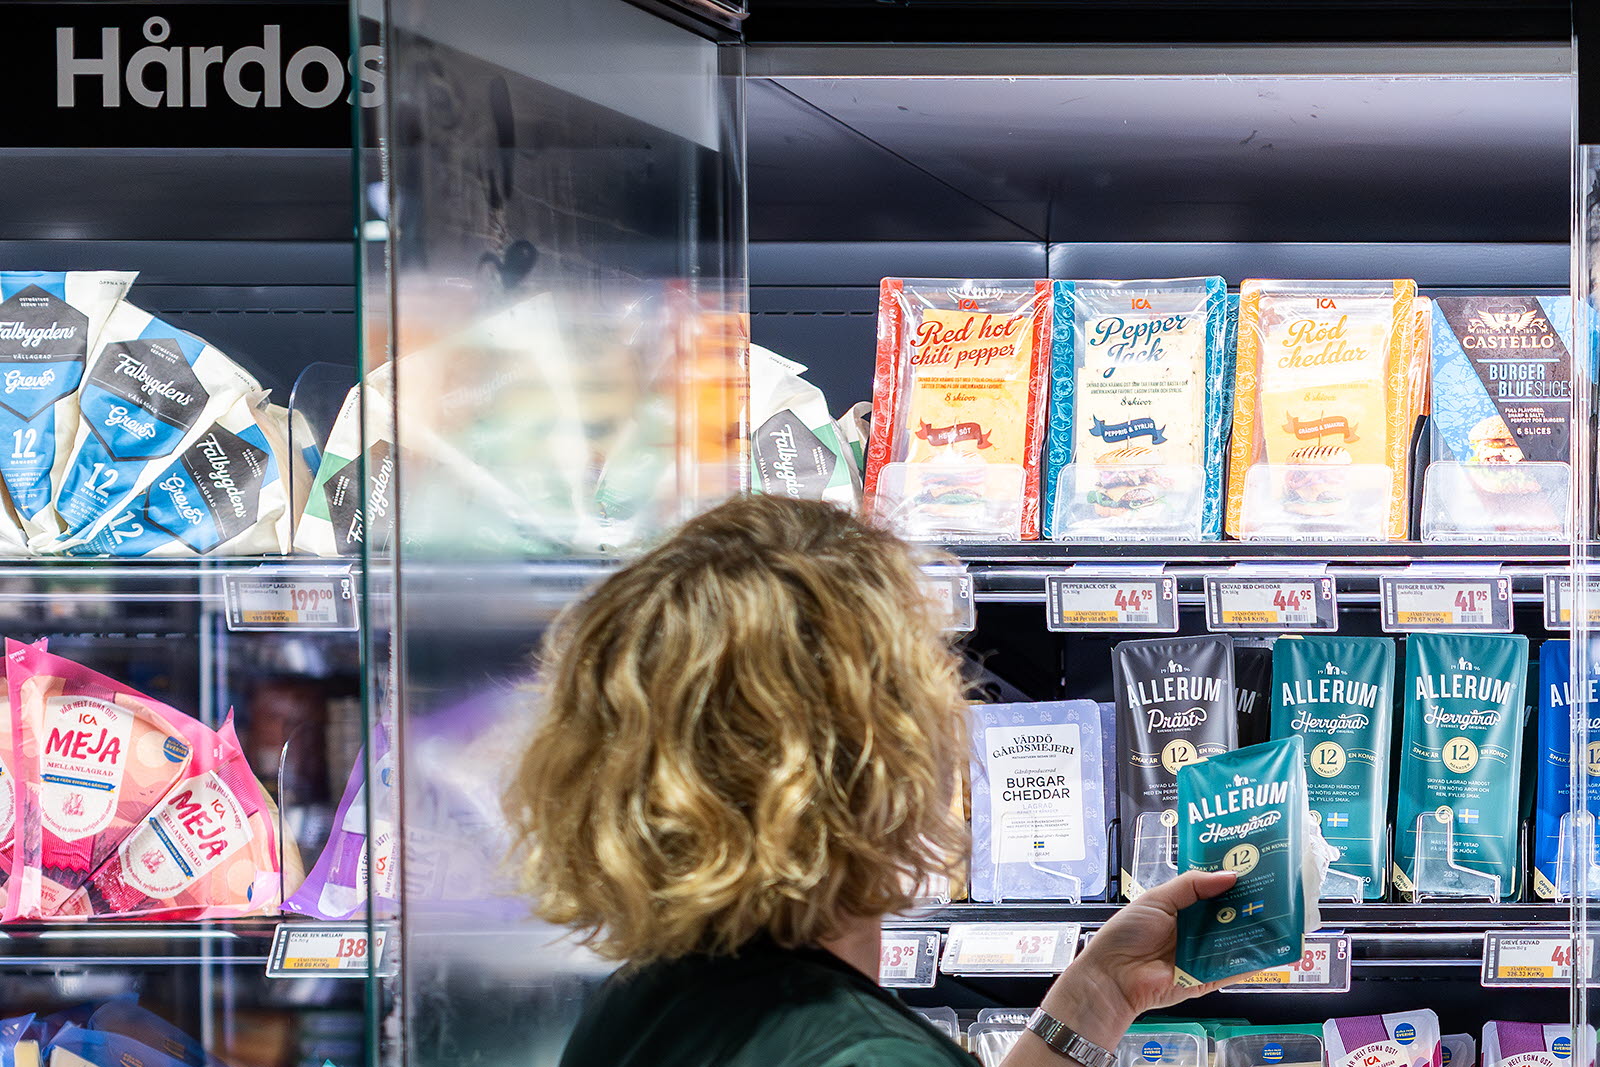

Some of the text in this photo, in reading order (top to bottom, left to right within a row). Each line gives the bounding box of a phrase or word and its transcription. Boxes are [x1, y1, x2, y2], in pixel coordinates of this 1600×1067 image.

[958, 298, 979, 310] ICA
[1131, 298, 1152, 310] ICA
[1316, 298, 1337, 310] ICA
[909, 313, 1022, 349] Red hot
[1090, 313, 1190, 347] Pepper
[1283, 314, 1348, 349] Röd
[1462, 334, 1554, 350] CASTELLO
[909, 343, 1016, 369] chili pepper
[1278, 339, 1371, 369] cheddar
[113, 352, 195, 406] Falbygdens
[1489, 364, 1546, 380] BURGER
[11, 428, 37, 458] 12
[84, 462, 119, 499] 12
[195, 432, 247, 519] Falbygdens
[111, 510, 145, 545] 12
[1126, 676, 1222, 709] ALLERUM
[1282, 678, 1378, 709] ALLERUM
[1416, 674, 1511, 705] ALLERUM
[78, 713, 98, 726] ICA
[1147, 706, 1207, 733] Präst
[1291, 710, 1370, 735] Herrgård
[1424, 705, 1502, 731] Herrgård
[45, 727, 121, 766] MEJA
[992, 741, 1075, 759] GÅRDSMEJERI
[1013, 732, 1053, 745] VÄDDÖ
[1170, 745, 1189, 764] 12
[1319, 749, 1337, 765] 12
[1451, 745, 1470, 762] 12
[46, 760, 114, 778] MELLANLAGRAD
[1006, 775, 1065, 789] BURGAR
[1002, 788, 1070, 802] CHEDDAR
[1188, 780, 1289, 825] ALLERUM
[168, 789, 229, 860] MEJA
[1199, 810, 1282, 843] Herrgård
[1232, 849, 1250, 867] 12
[1363, 1056, 1381, 1067] ICA
